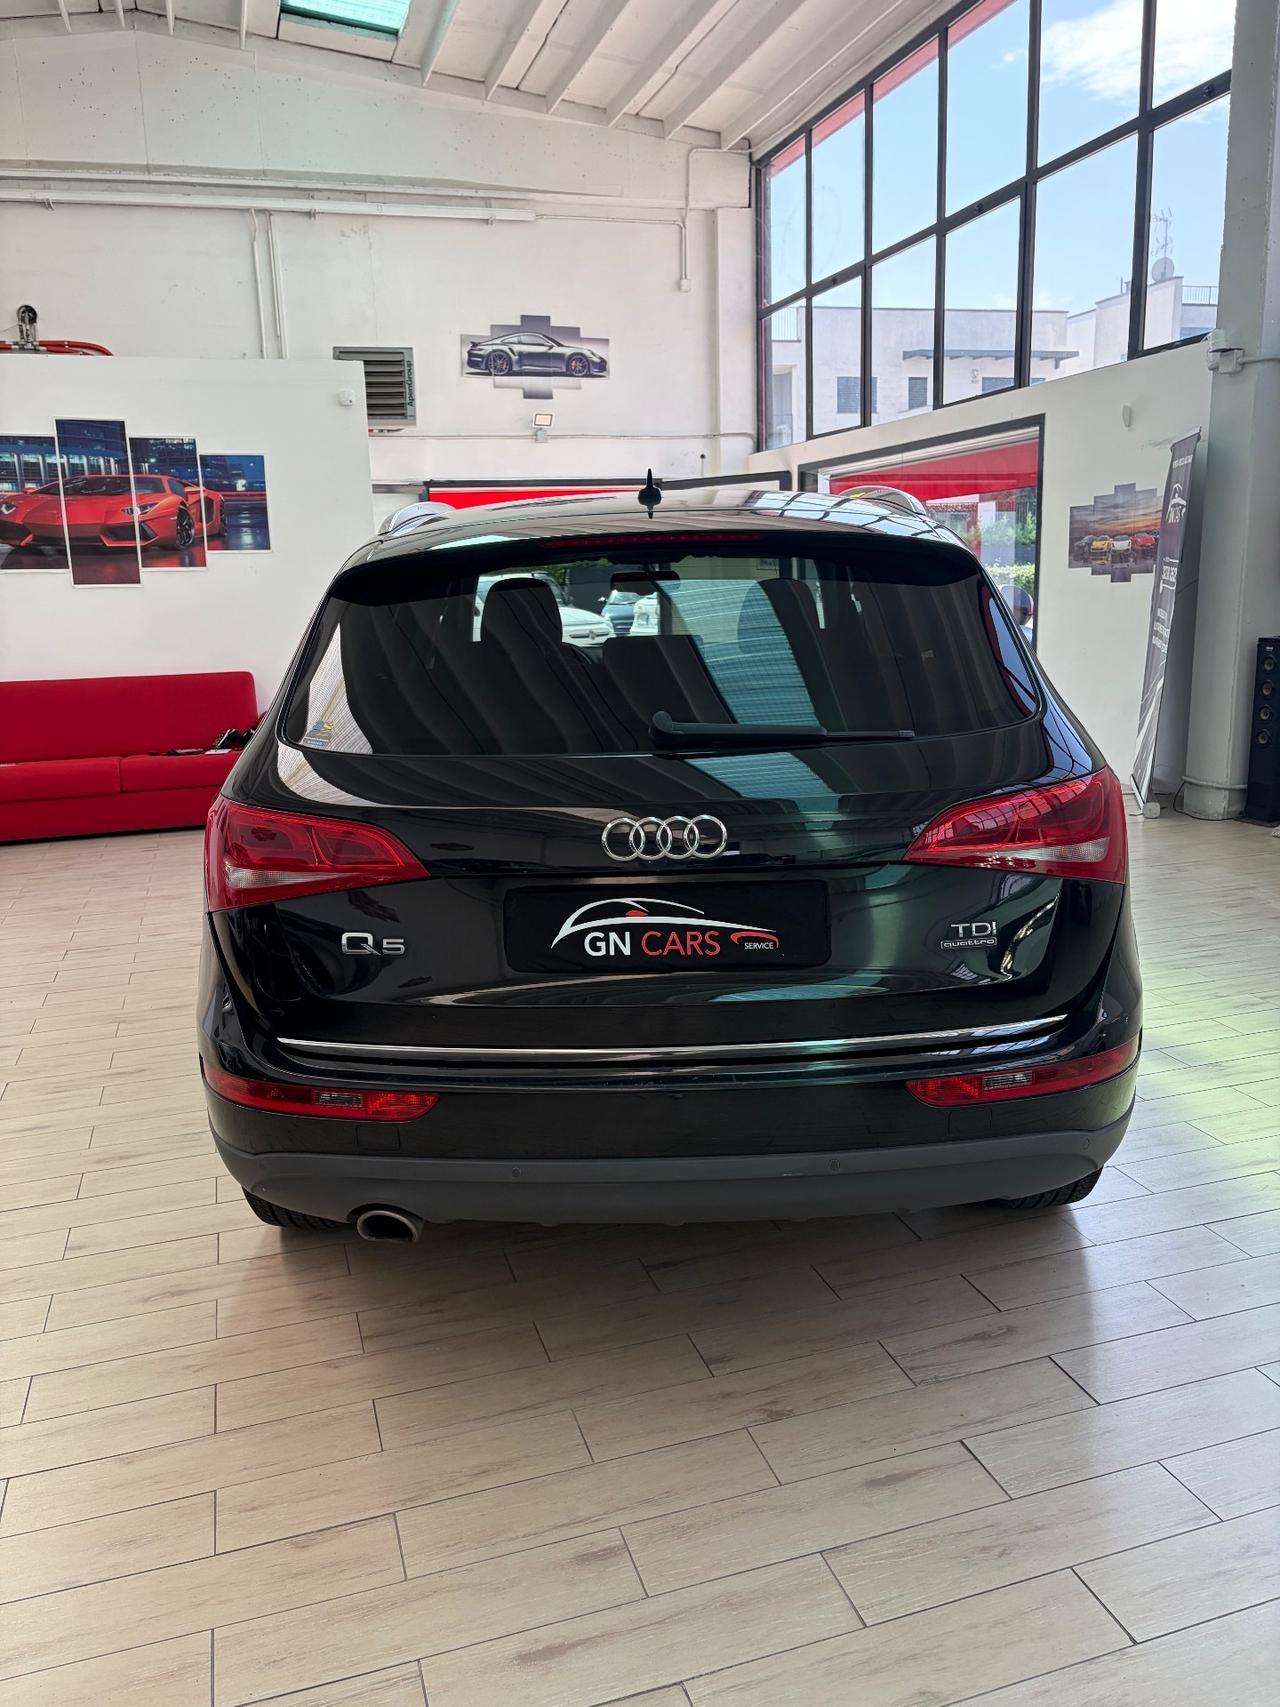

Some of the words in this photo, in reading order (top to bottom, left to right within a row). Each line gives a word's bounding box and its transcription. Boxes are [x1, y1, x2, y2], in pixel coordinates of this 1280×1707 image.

[405, 360, 415, 407] ApenGroup
[950, 921, 997, 938] TDI
[341, 932, 405, 956] Q5
[583, 931, 632, 957] GN
[640, 930, 722, 957] CARS
[744, 941, 775, 951] SERVICE
[943, 938, 996, 949] quattro
